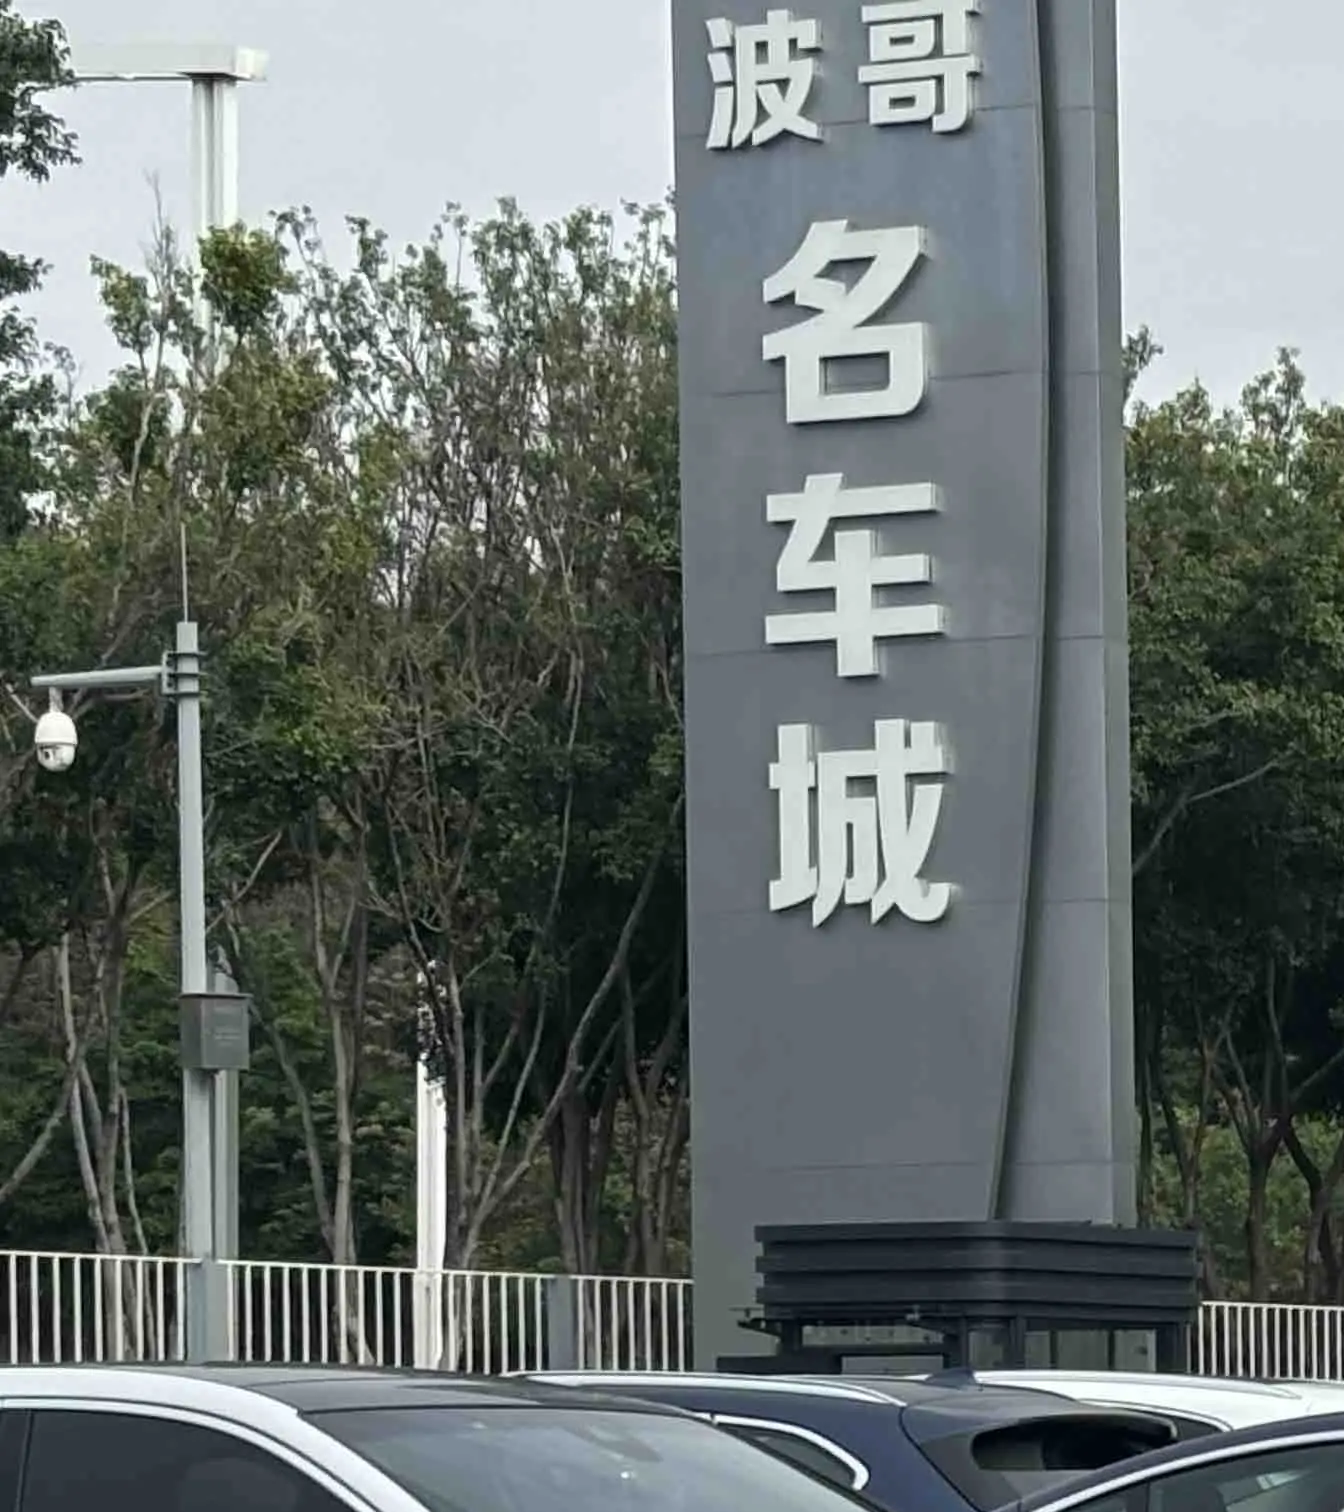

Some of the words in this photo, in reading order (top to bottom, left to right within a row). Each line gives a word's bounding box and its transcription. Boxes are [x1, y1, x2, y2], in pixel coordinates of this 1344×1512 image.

[705, 0, 981, 150] 波哥
[762, 218, 955, 926] 名车城
